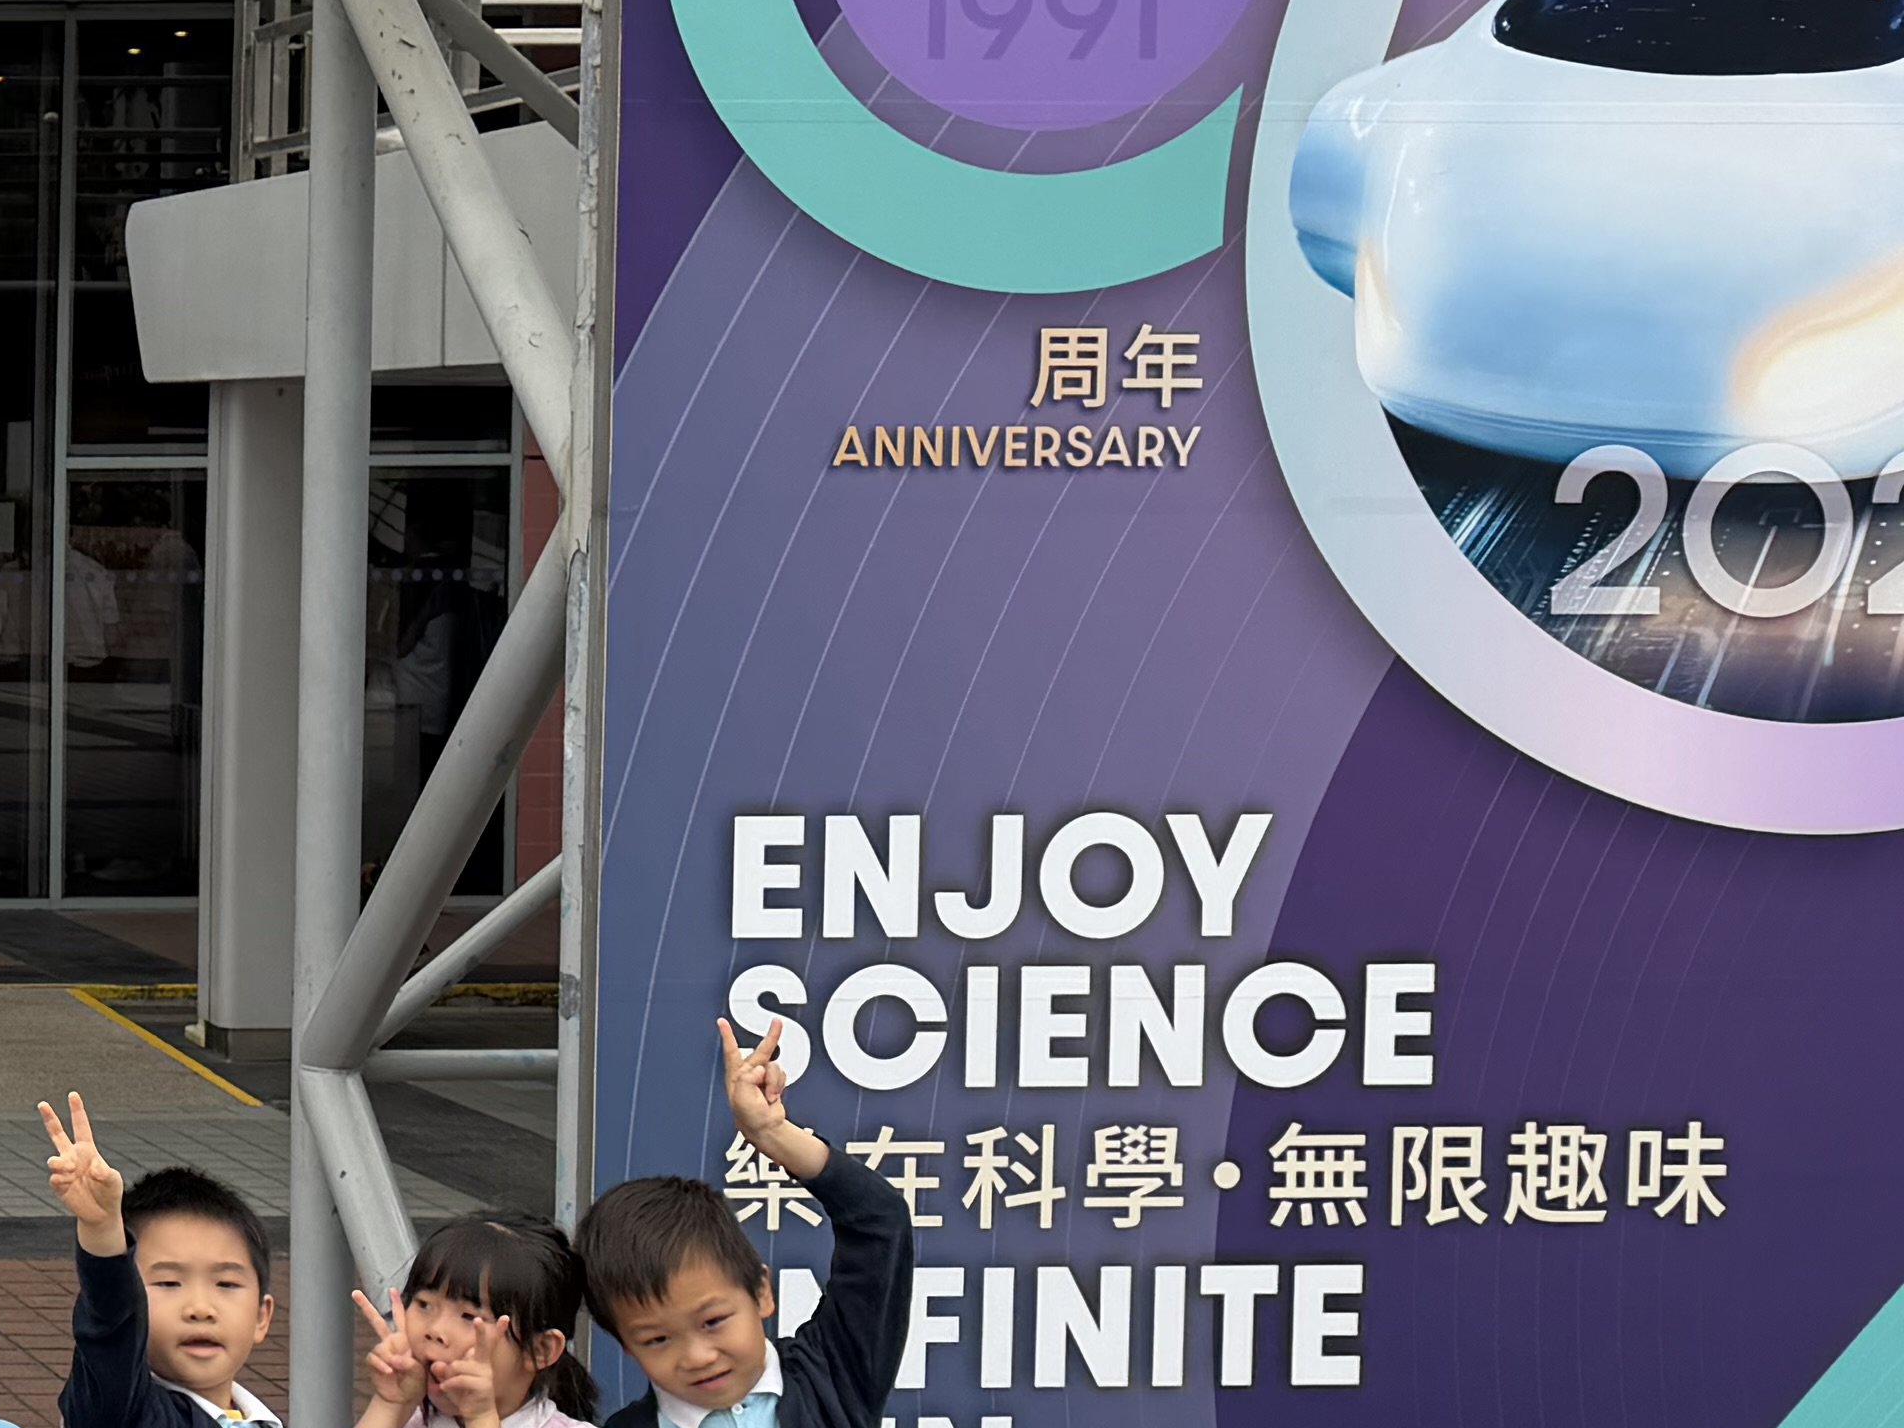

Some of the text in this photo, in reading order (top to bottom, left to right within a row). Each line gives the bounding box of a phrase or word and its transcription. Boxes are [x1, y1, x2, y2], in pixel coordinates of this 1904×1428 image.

[1028, 323, 1203, 412] 周年
[830, 425, 1202, 472] ANNIVERSARY
[731, 812, 1274, 940] ENJOY
[728, 962, 1436, 1091] SCIENCE
[777, 1264, 1365, 1389] FINITE
